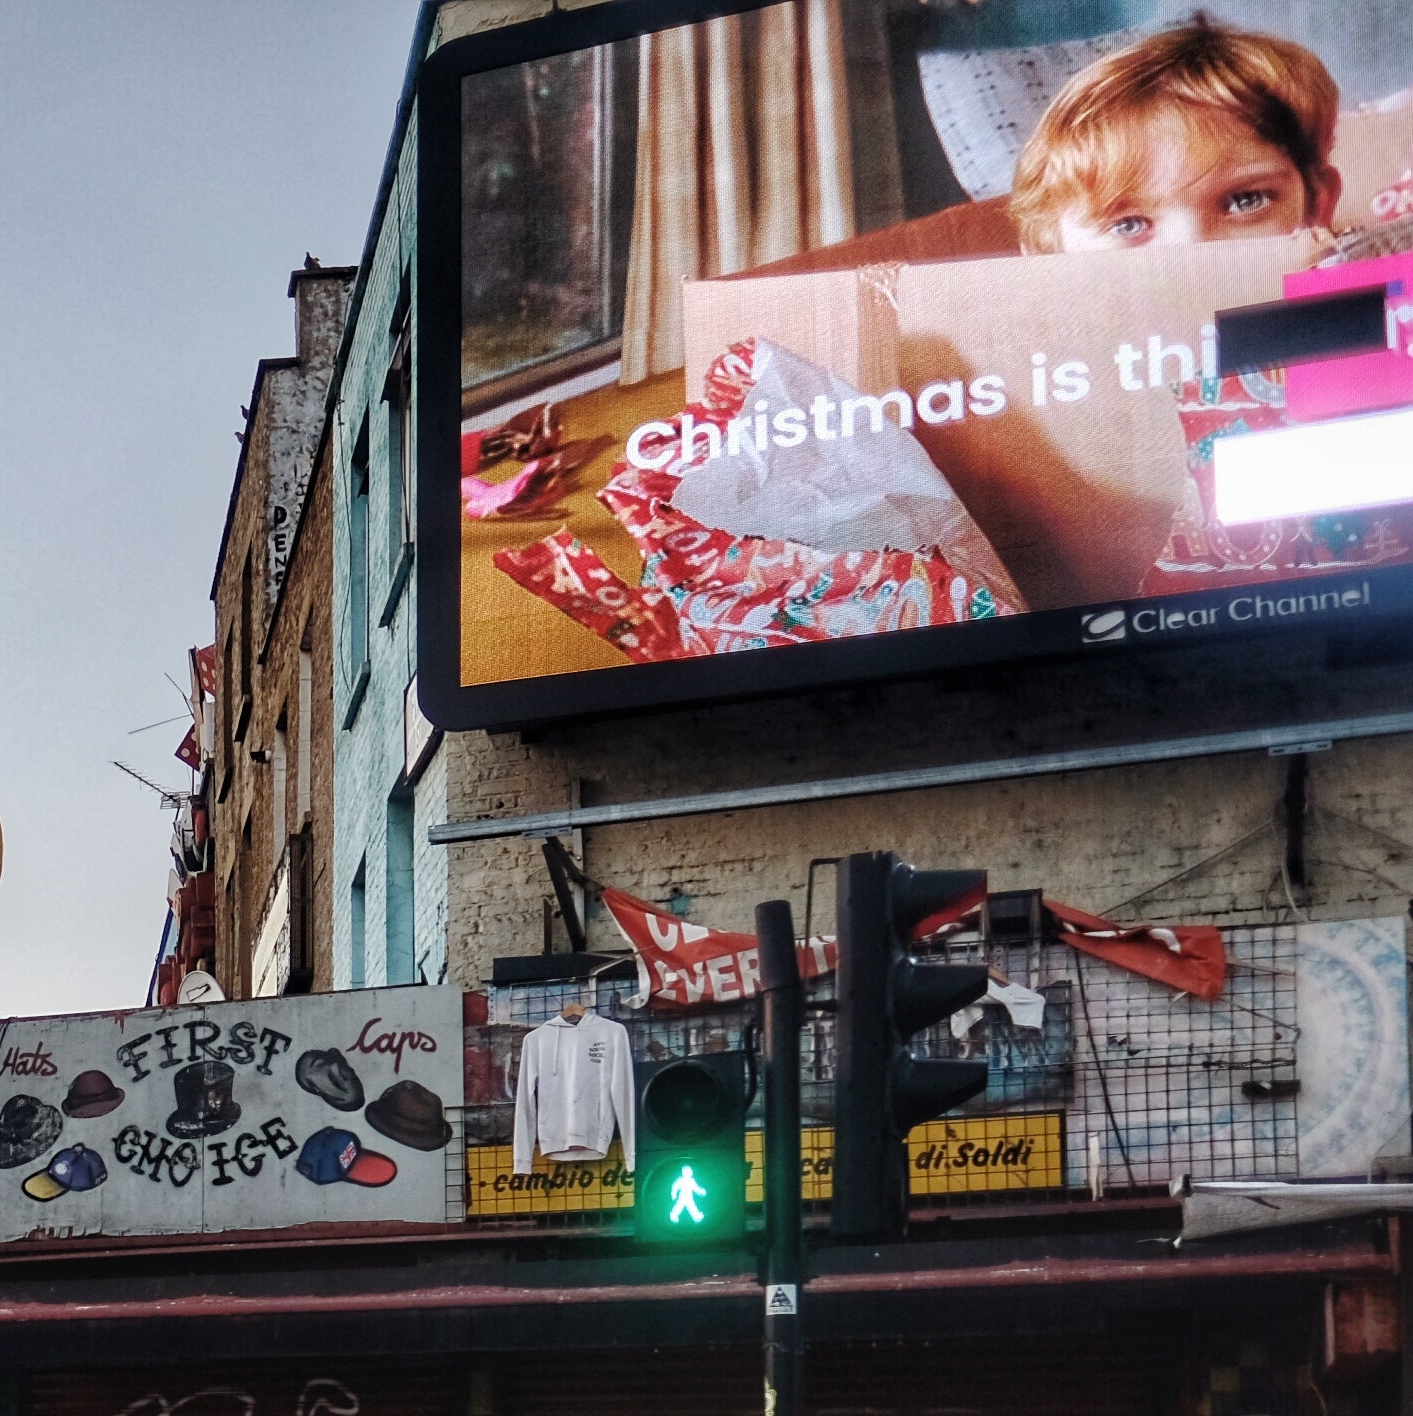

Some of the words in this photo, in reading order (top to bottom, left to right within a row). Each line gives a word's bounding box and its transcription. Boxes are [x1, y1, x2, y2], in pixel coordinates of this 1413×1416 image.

[625, 364, 1006, 472] Christmas
[1033, 351, 1090, 404] is
[1115, 325, 1218, 391] thi
[1132, 606, 1216, 635] Clear
[1226, 581, 1370, 622] Channel
[116, 1020, 292, 1084] FIRST
[346, 1017, 437, 1074] Caps
[112, 1116, 299, 1188] CHOICE
[493, 1163, 595, 1193] cambio
[601, 1163, 635, 1187] de
